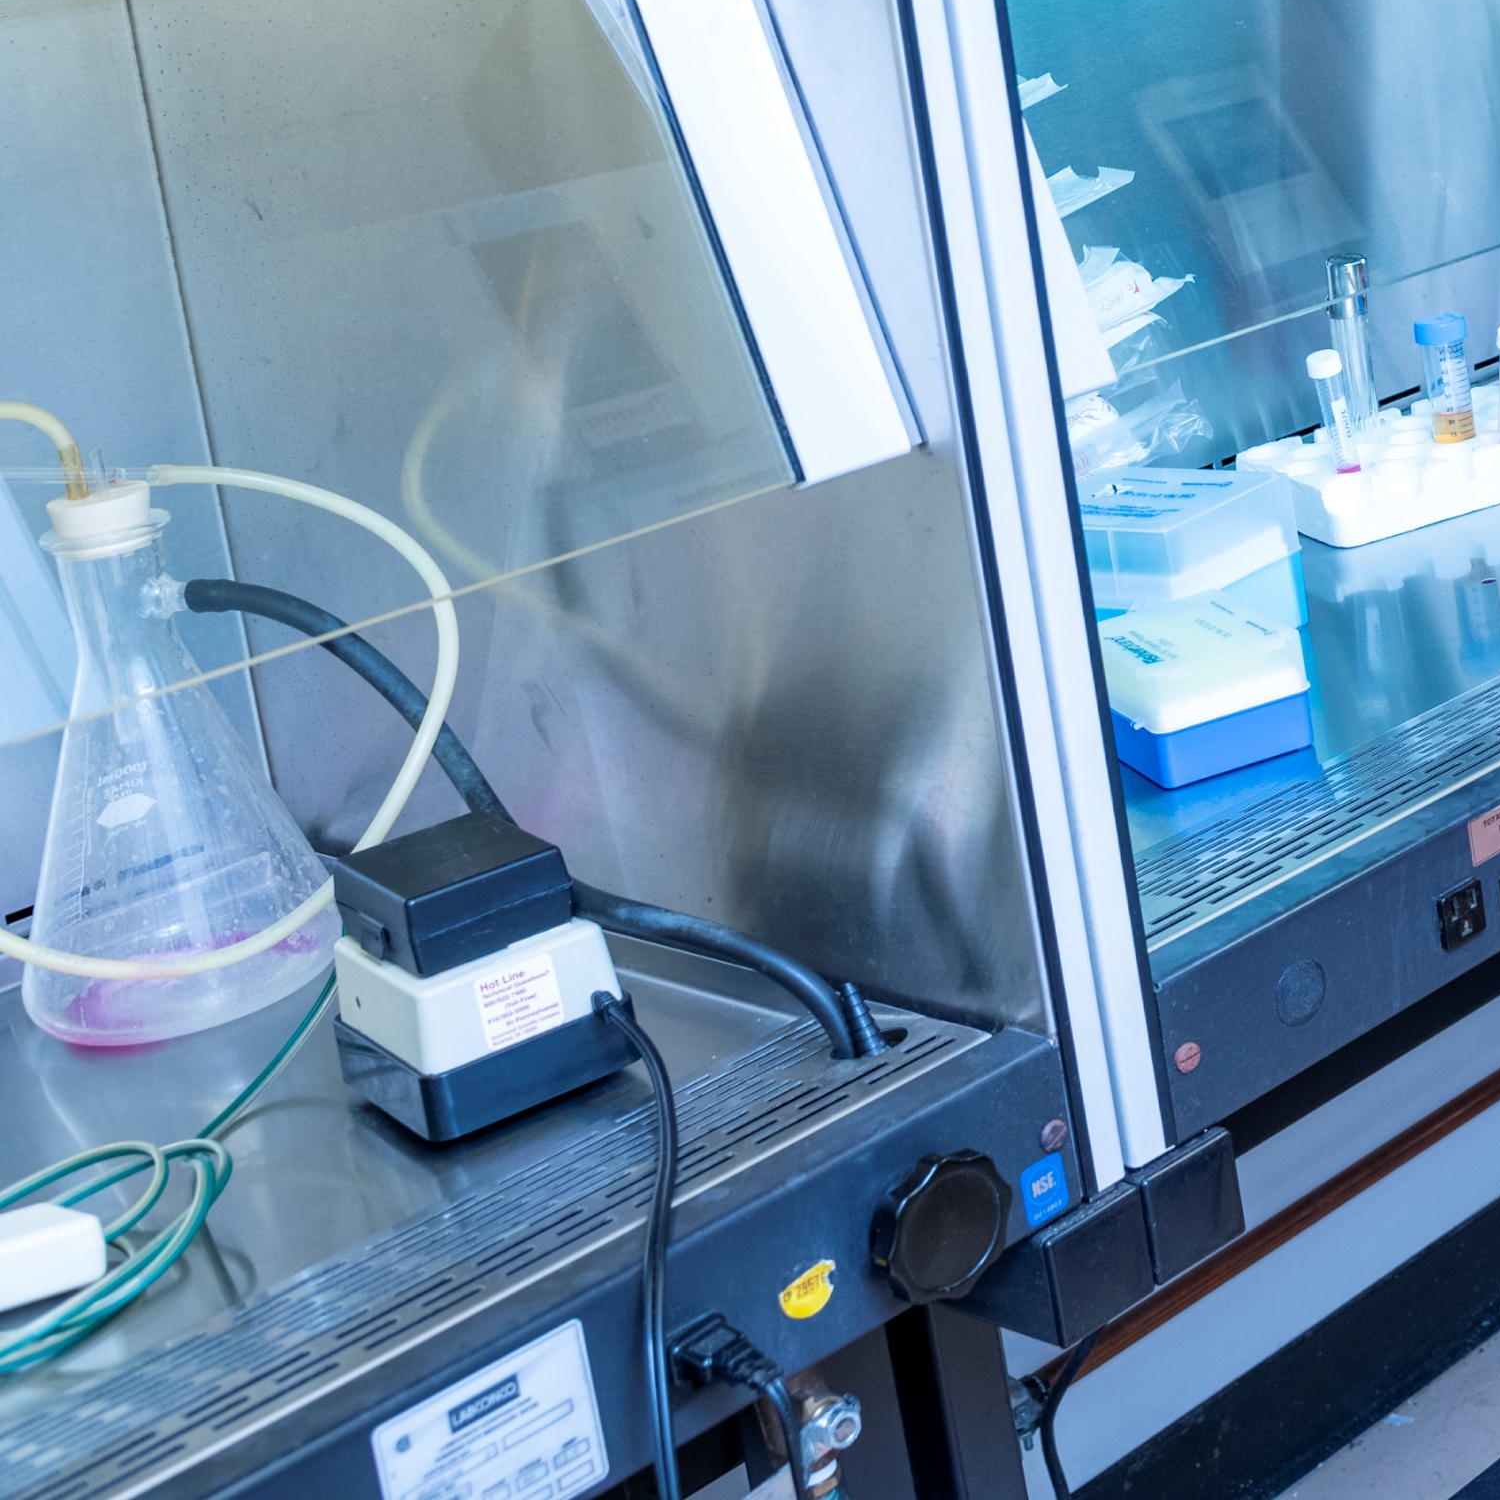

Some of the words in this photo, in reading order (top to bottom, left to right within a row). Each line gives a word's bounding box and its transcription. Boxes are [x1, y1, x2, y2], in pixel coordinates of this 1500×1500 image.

[480, 979, 500, 993] Hot
[502, 970, 525, 985] Line
[482, 984, 512, 1000] Technical
[514, 969, 550, 988] Questions?
[451, 1380, 518, 1428] LABCONCO
